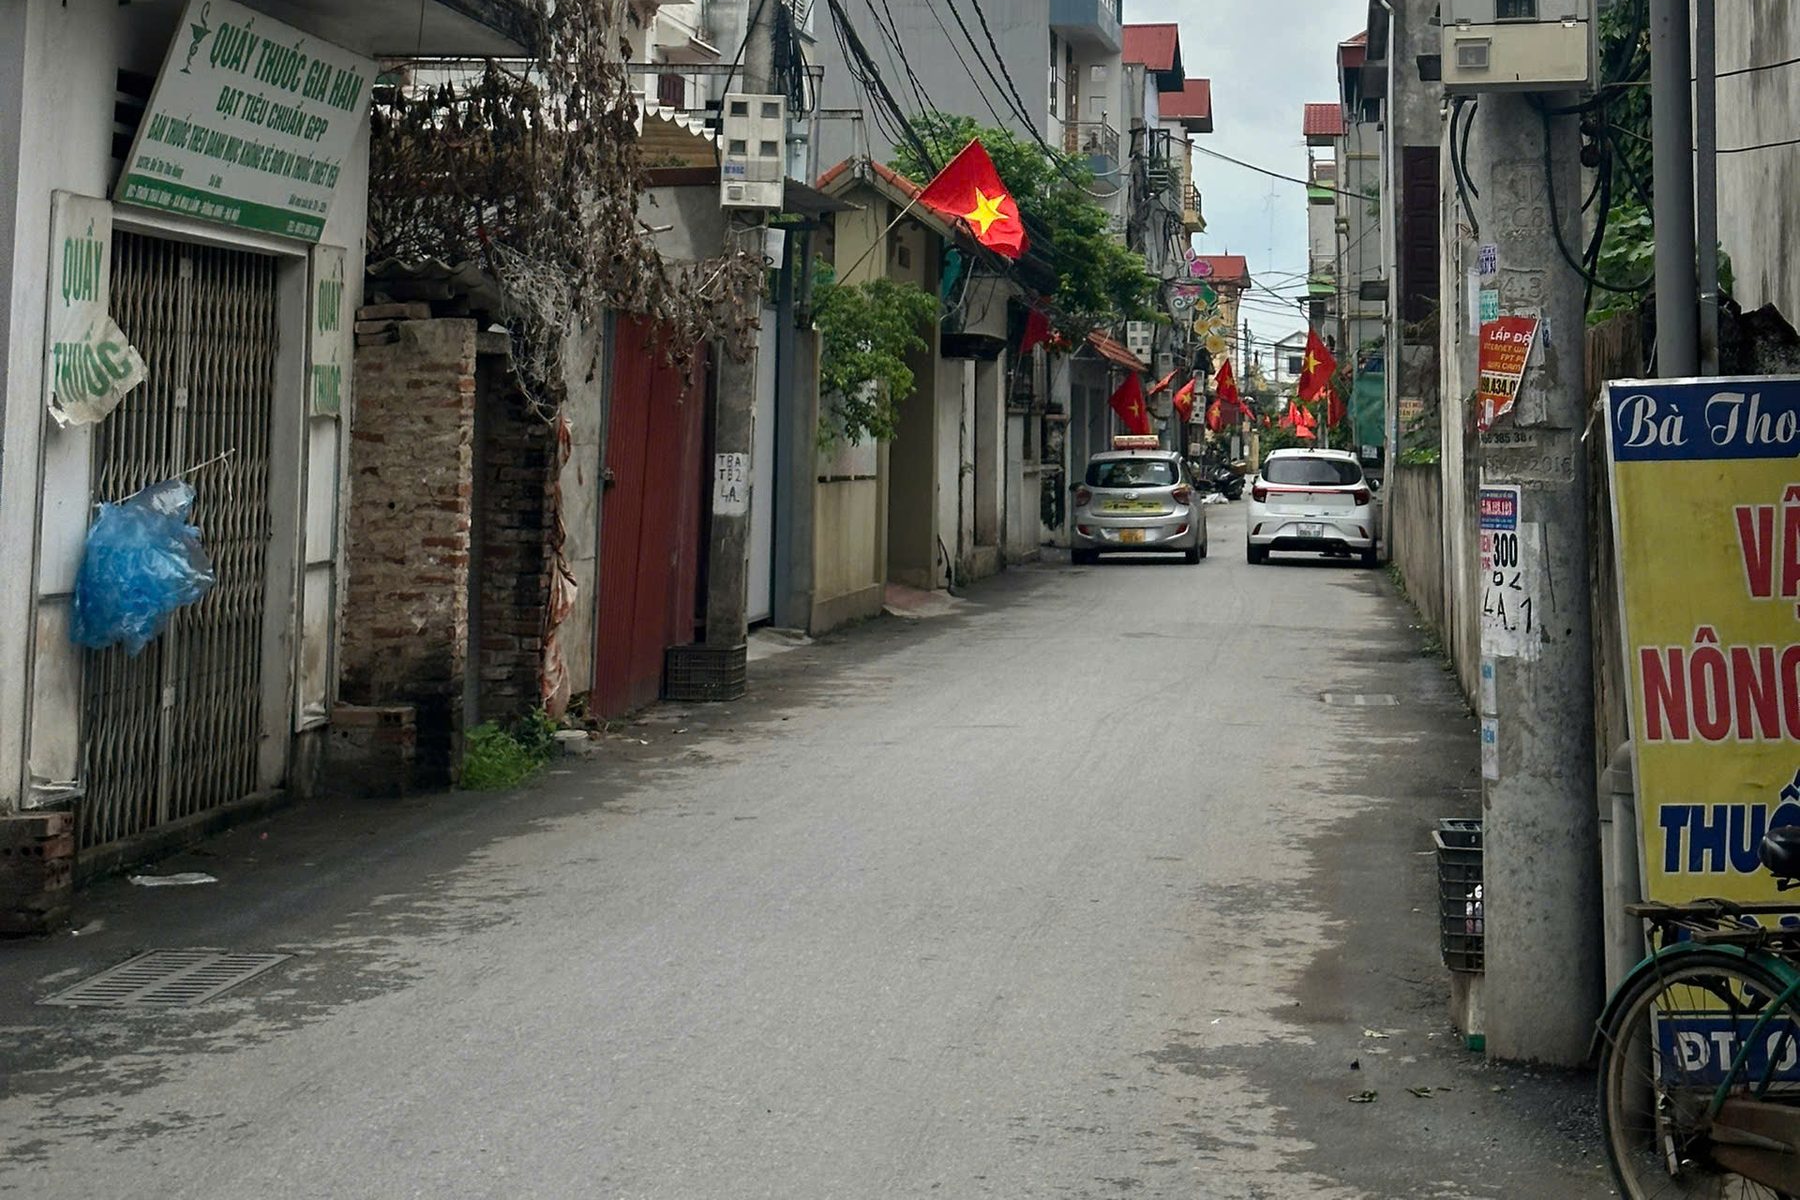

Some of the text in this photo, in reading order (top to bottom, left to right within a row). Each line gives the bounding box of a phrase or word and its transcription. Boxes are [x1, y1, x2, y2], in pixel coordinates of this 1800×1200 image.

[253, 37, 308, 93] THUỐC
[301, 58, 333, 103] GIA
[215, 85, 329, 143] ĐẠT TIÊU CHUẨN GPP
[53, 322, 134, 402] THUỐC
[1490, 326, 1511, 342] LẮP
[1513, 330, 1533, 347] ĐẶ
[1616, 393, 1689, 448] Bà
[718, 454, 742, 468] TBA
[1492, 532, 1518, 568] 300
